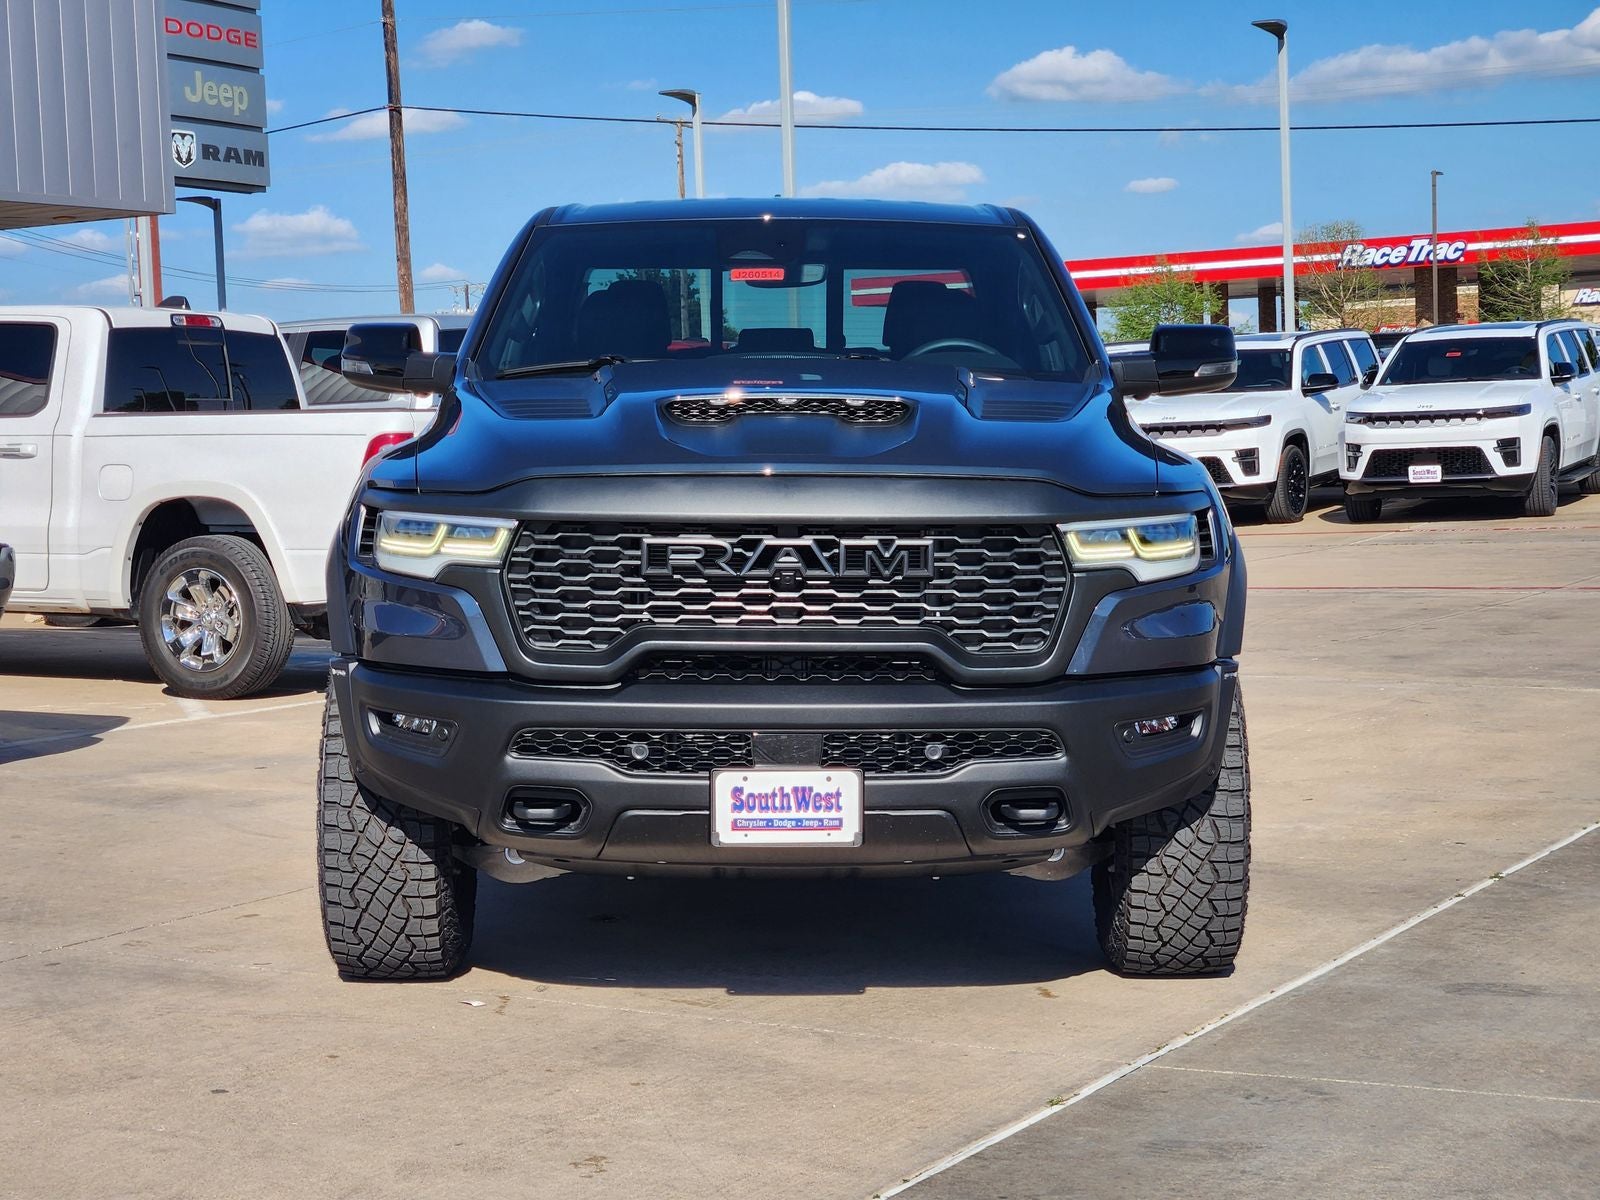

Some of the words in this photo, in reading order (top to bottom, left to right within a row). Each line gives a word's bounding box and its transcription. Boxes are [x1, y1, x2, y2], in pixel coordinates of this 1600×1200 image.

[164, 17, 258, 48] DODGE
[184, 71, 249, 116] Jeep
[201, 143, 265, 167] RAM
[1341, 238, 1466, 268] RaceTrac
[641, 537, 935, 577] RAM
[731, 786, 842, 813] SouthWest
[737, 819, 766, 828] Chrysler
[773, 819, 796, 828] Dodge
[801, 819, 819, 828] Jeep
[823, 819, 840, 827] Ram
